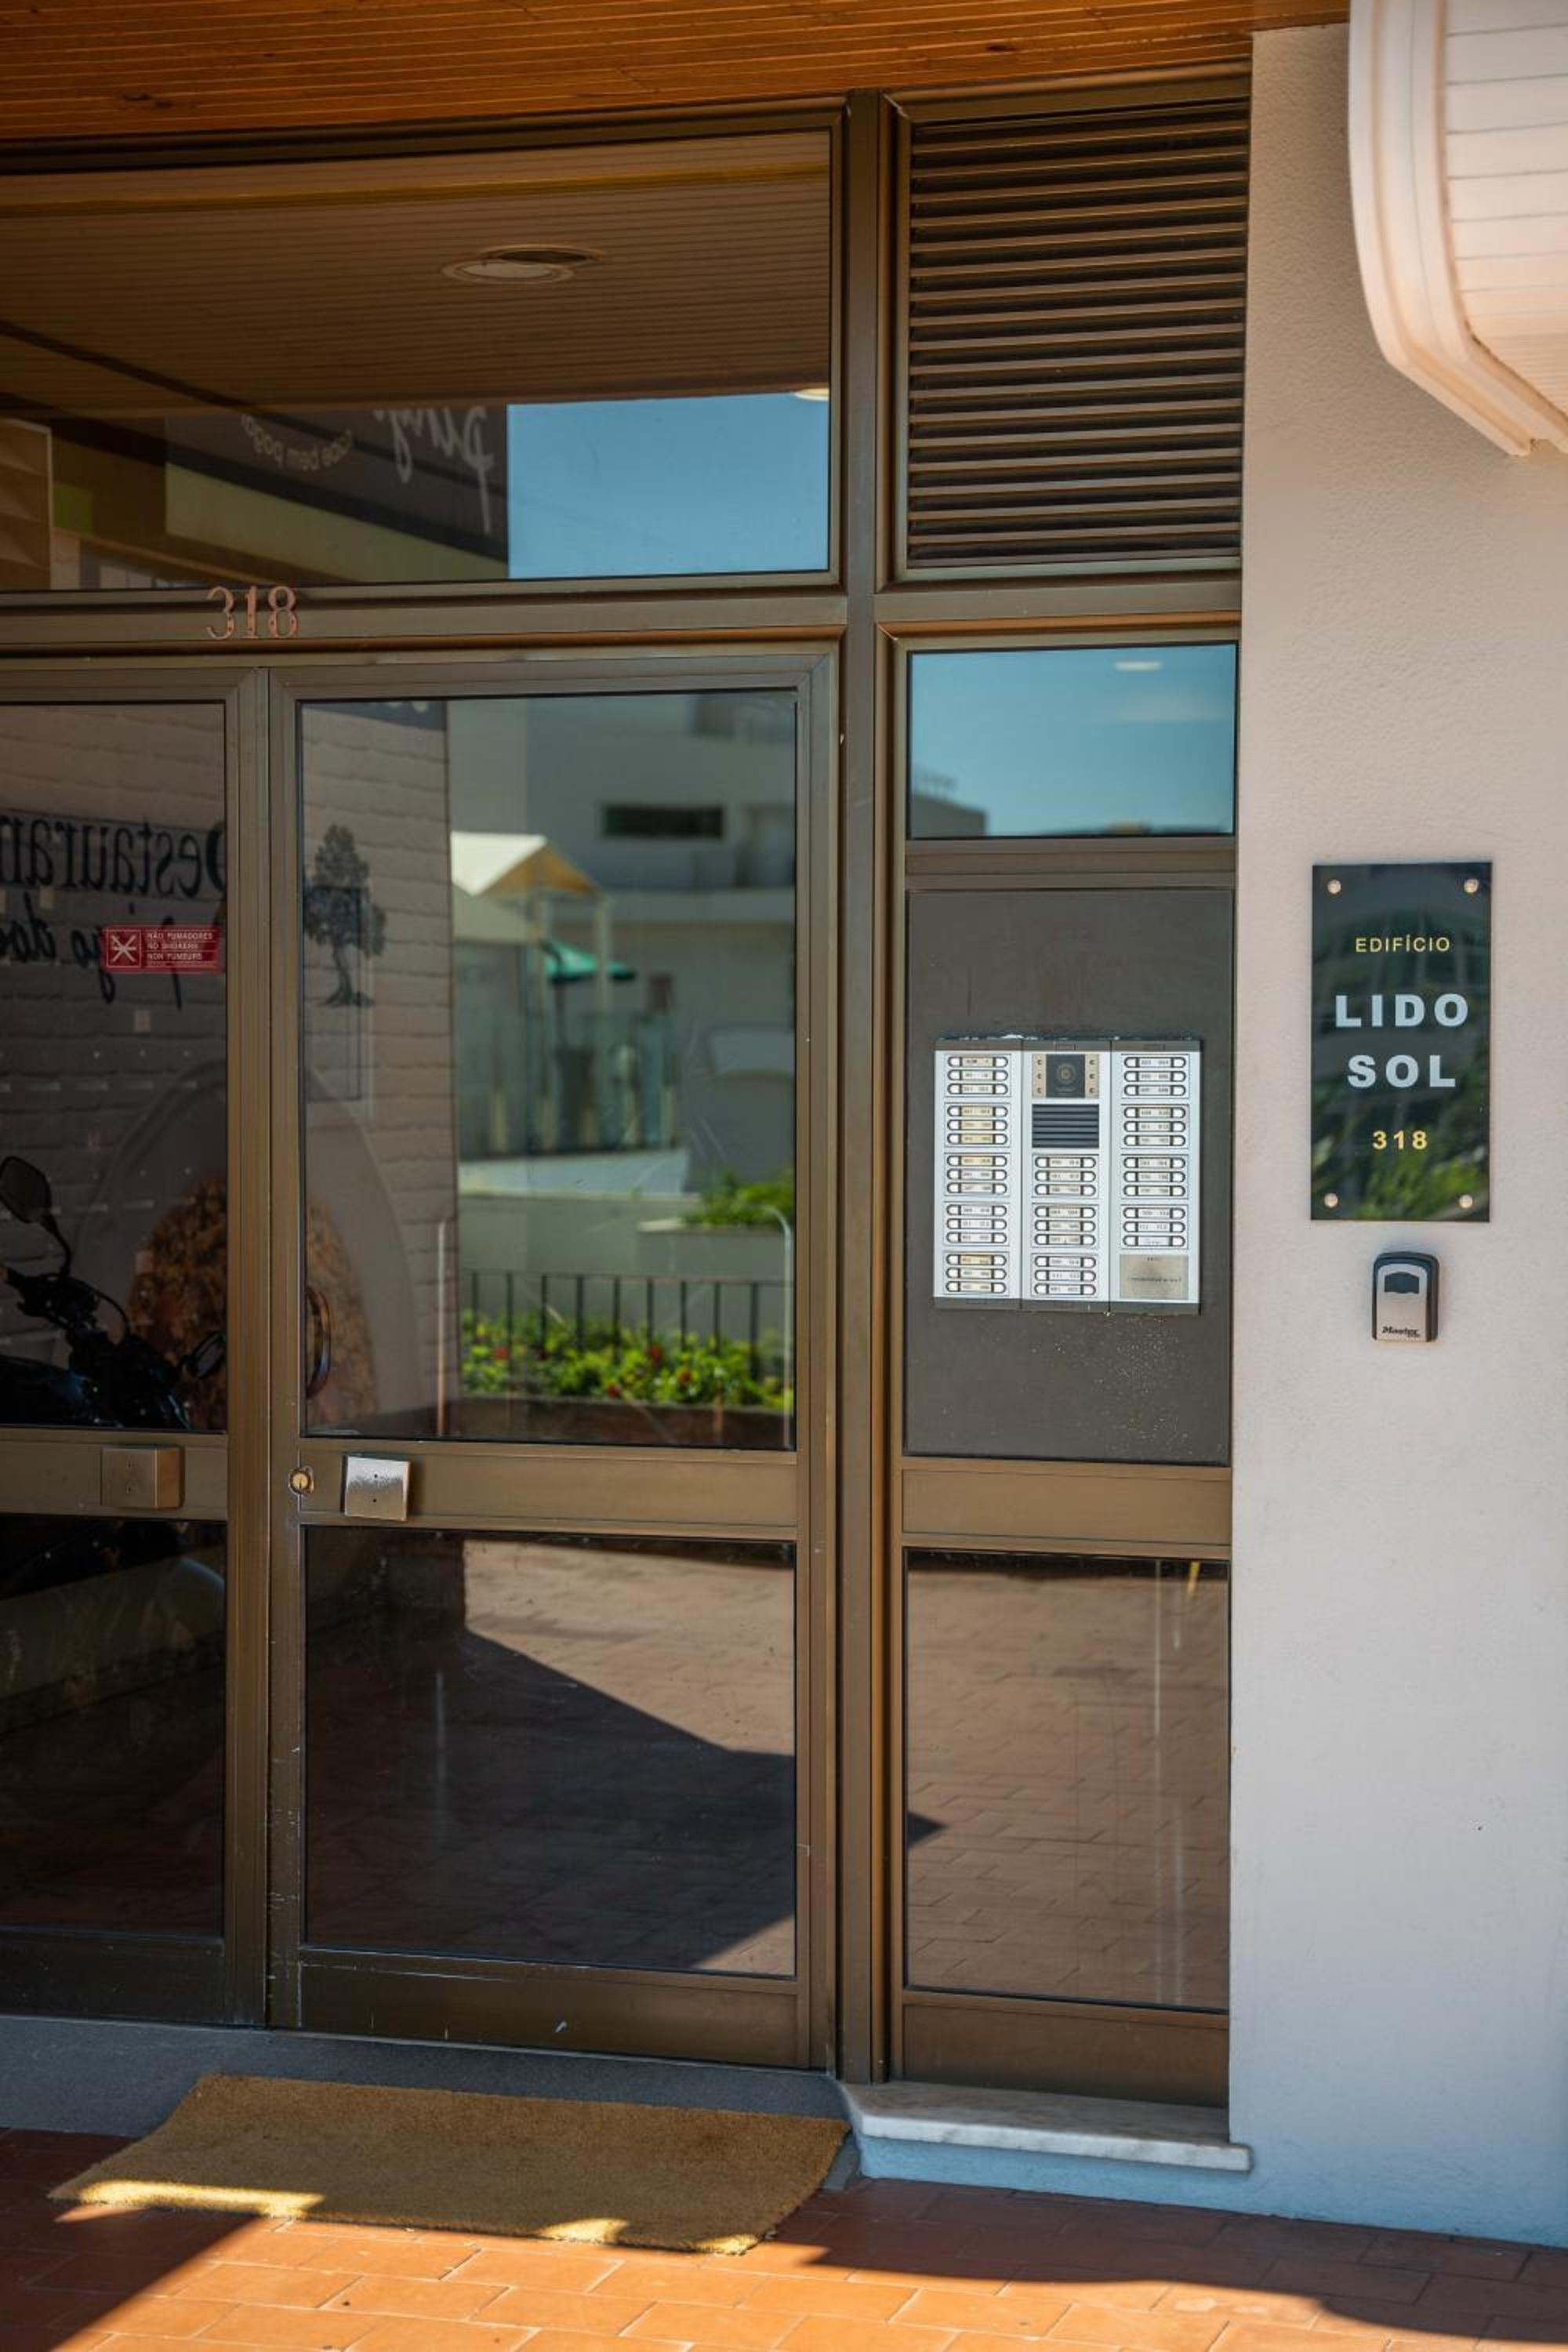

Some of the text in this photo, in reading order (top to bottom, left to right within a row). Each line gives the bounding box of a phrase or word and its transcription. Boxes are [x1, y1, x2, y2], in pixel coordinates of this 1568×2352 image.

[206, 586, 298, 640] 318
[1355, 934, 1450, 953] EDIFÍCIO
[1335, 993, 1468, 1028] LIDO
[1347, 1054, 1456, 1088] SOL
[1373, 1130, 1428, 1150] 318
